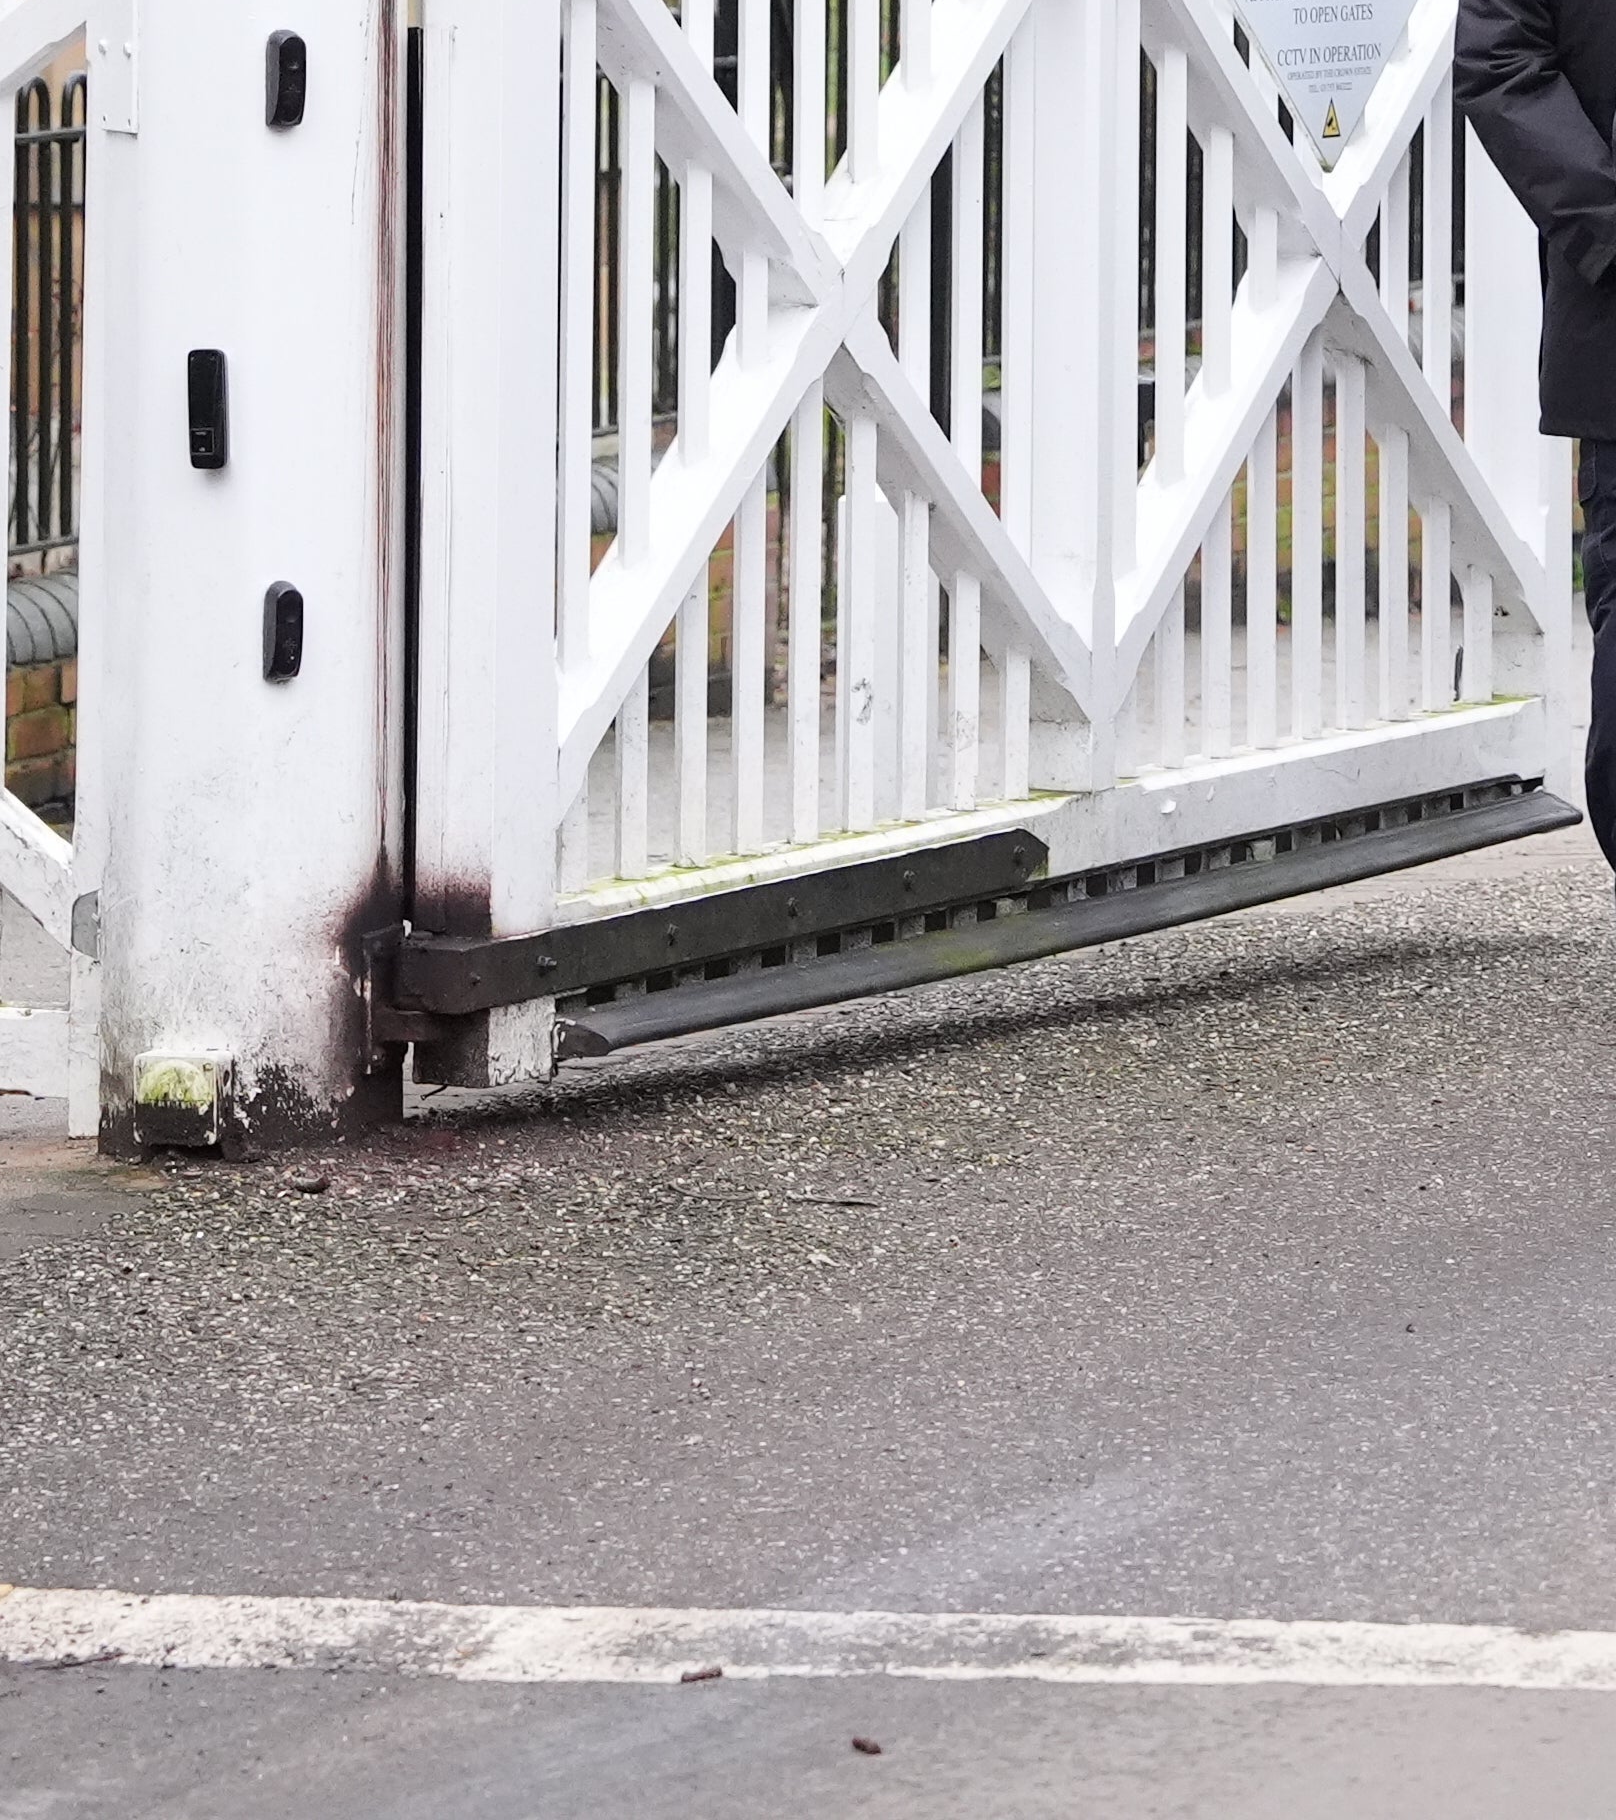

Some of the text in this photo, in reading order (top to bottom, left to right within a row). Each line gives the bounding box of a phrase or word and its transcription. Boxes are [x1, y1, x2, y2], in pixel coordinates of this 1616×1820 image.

[1293, 3, 1373, 24] TO OPEN GATES
[1277, 43, 1382, 67] CCTV IN OPERATION
